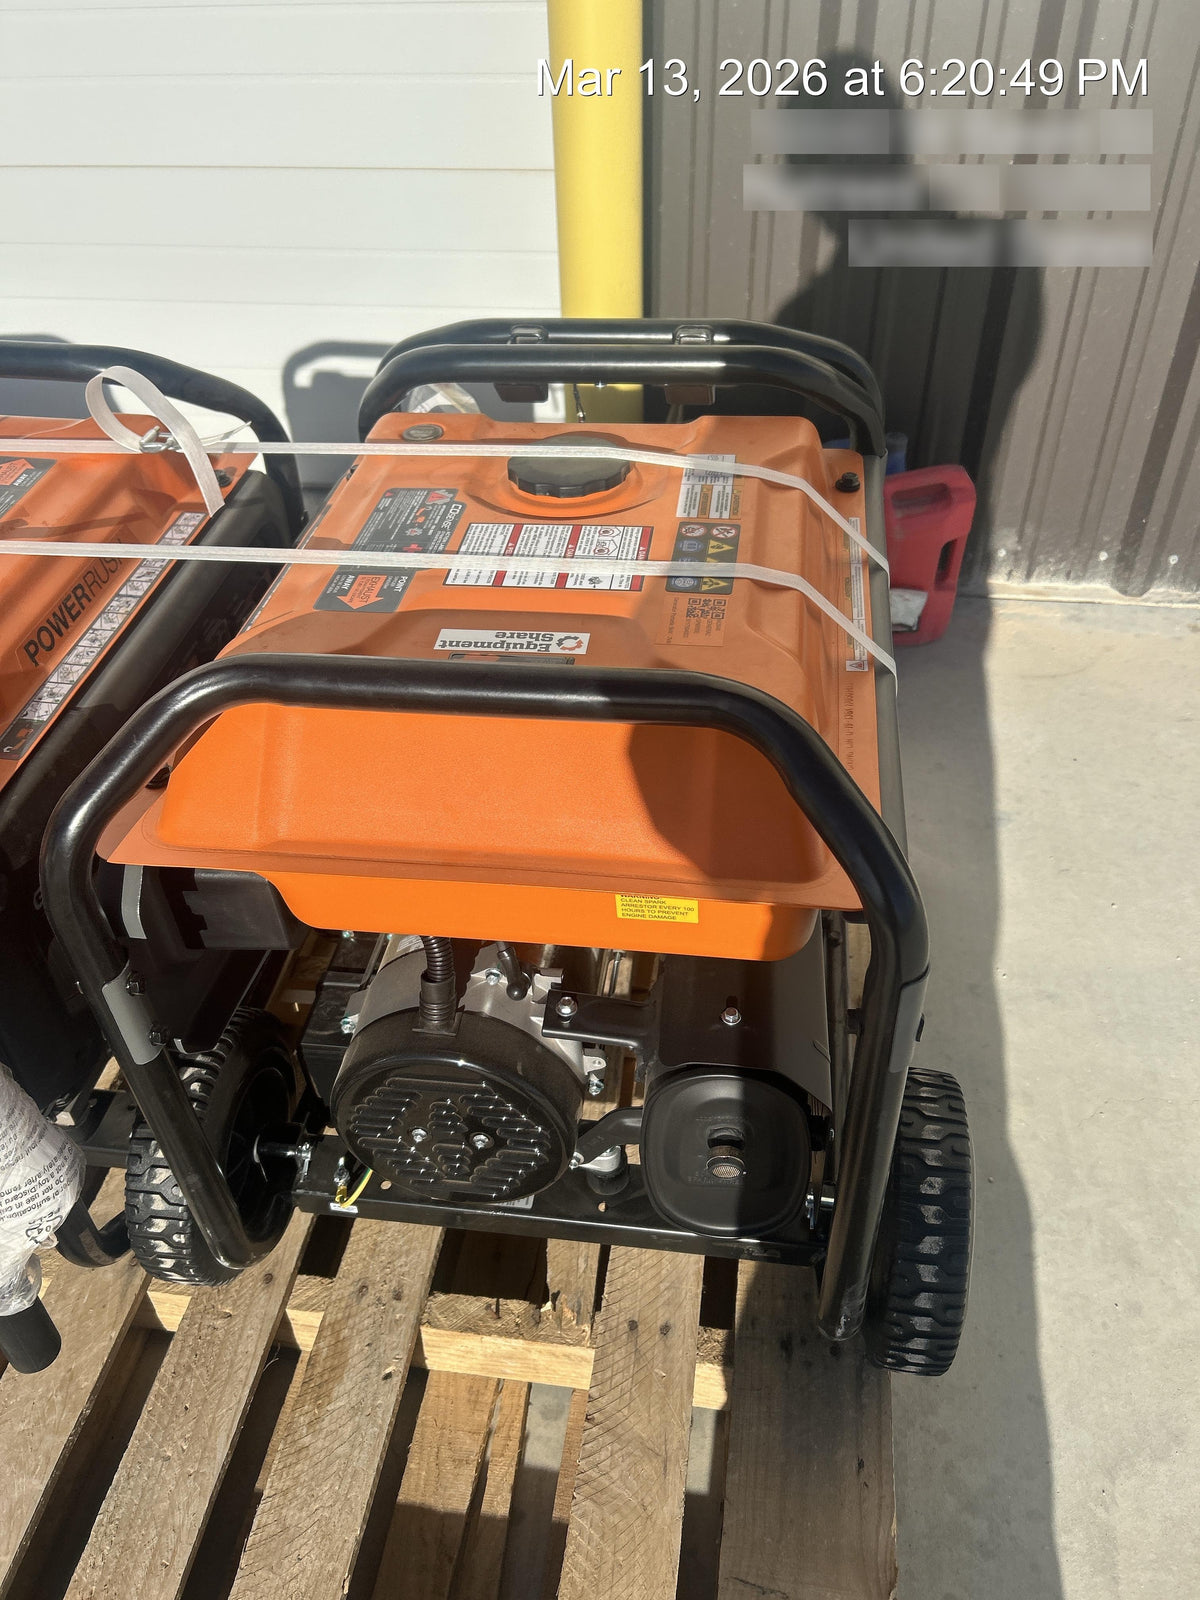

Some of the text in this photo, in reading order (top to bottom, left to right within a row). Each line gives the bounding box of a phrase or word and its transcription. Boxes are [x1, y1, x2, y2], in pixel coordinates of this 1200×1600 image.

[341, 574, 354, 590] AWAY
[394, 576, 408, 592] POINT
[359, 577, 380, 603] EXHAUST
[23, 538, 122, 667] POWERRUS
[494, 631, 555, 642] Share
[438, 640, 552, 652] Equipment
[56, 1162, 66, 1174] not
[24, 1172, 43, 1187] after
[55, 1174, 64, 1186] Do
[41, 1184, 54, 1195] not
[52, 1190, 60, 1200] of
[25, 1192, 40, 1205] use
[14, 1201, 23, 1209] in
